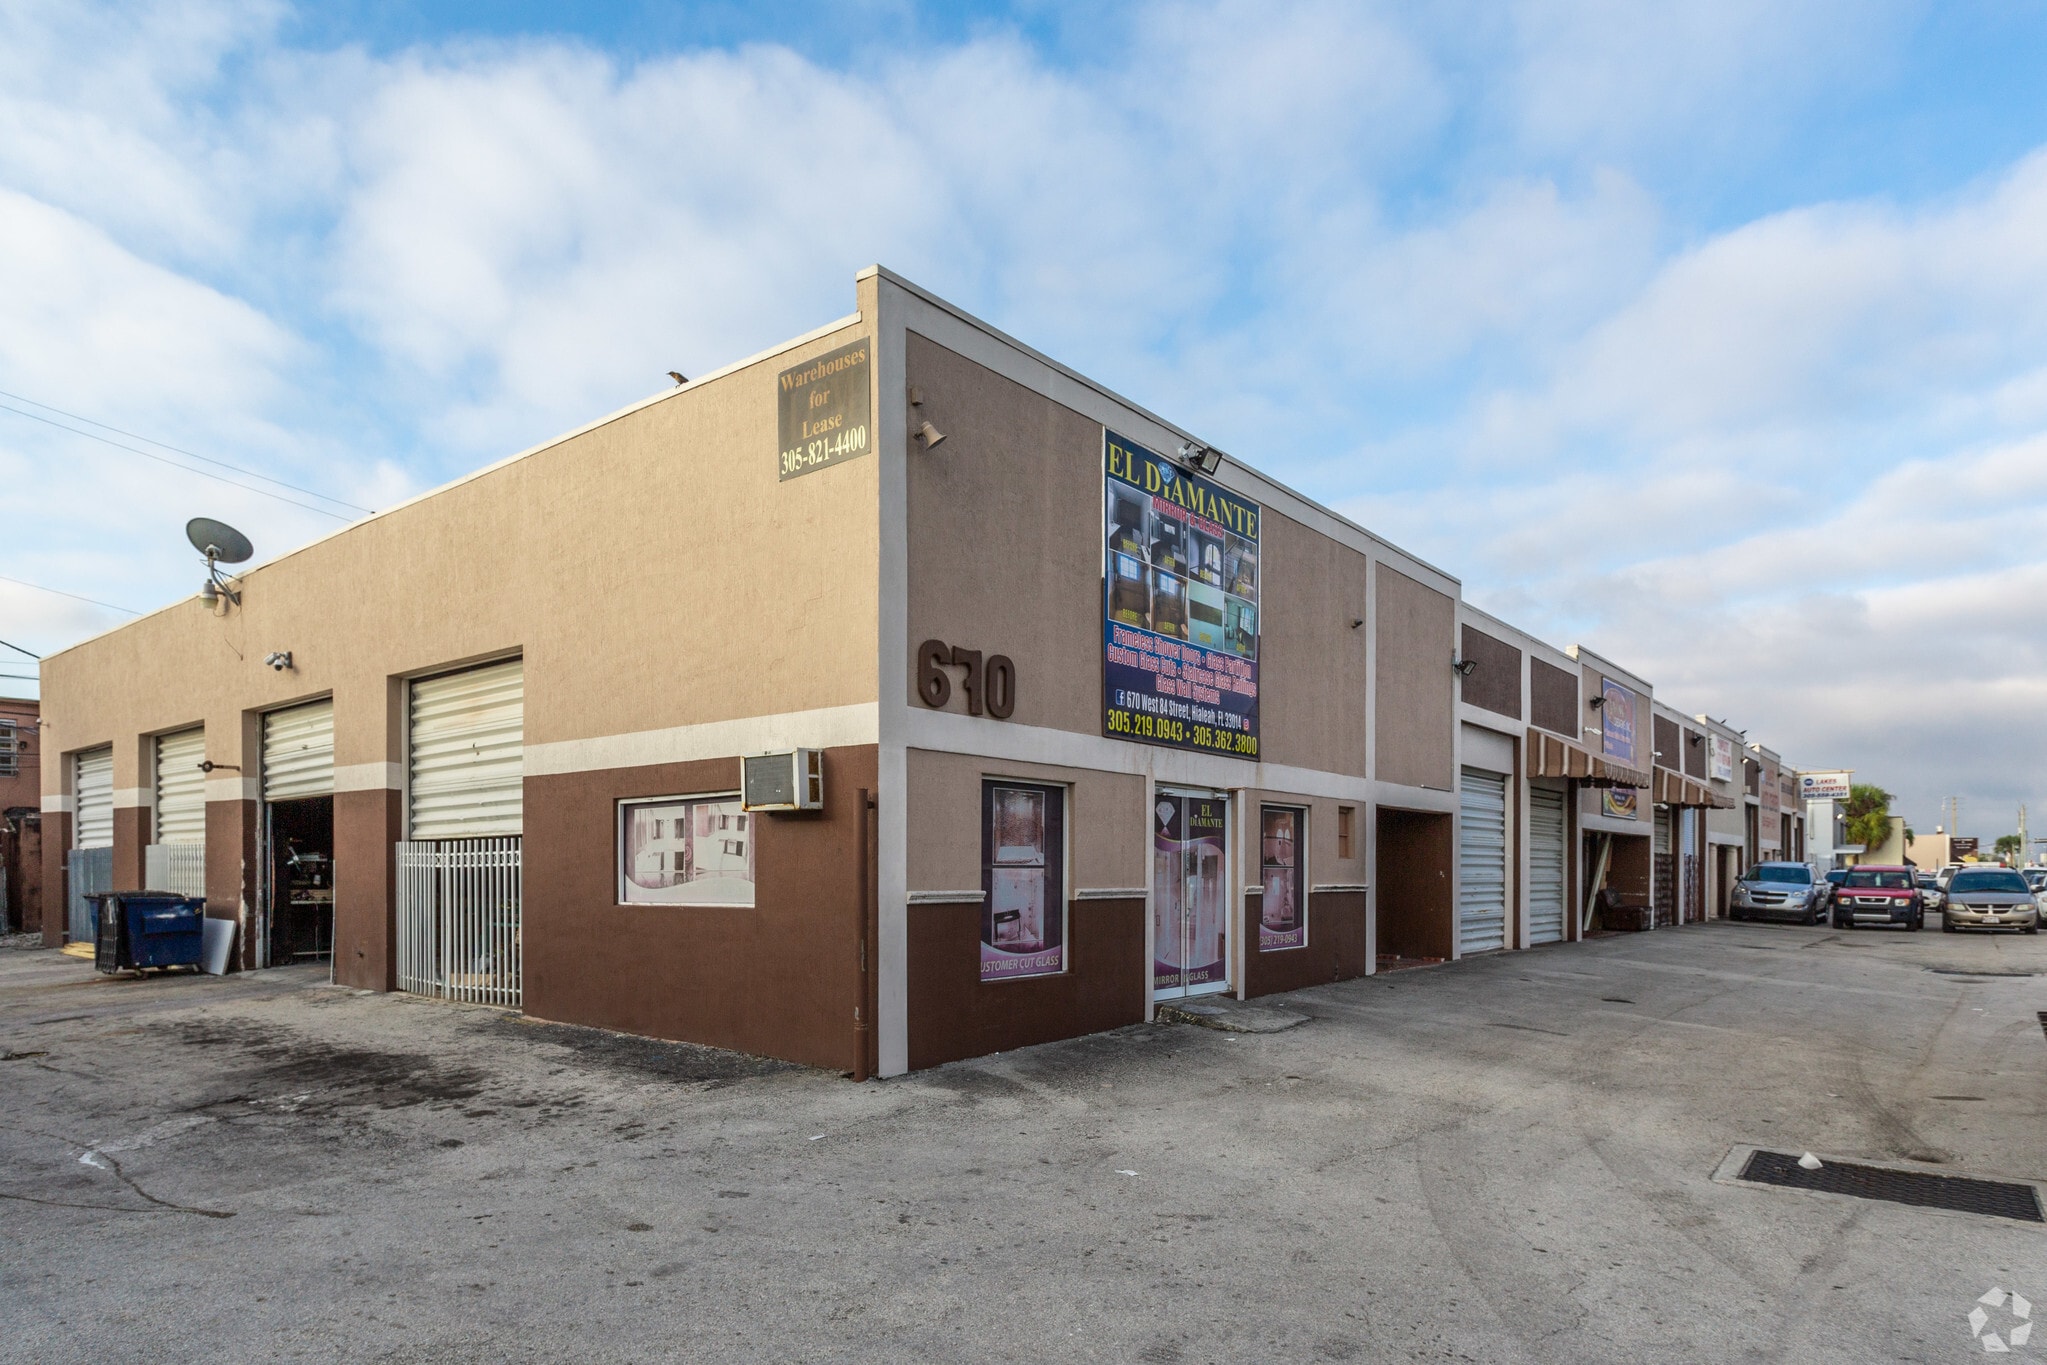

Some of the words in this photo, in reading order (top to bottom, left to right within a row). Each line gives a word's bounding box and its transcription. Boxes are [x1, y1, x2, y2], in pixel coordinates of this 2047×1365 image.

[780, 349, 866, 392] Warehouses
[809, 390, 830, 409] for
[802, 413, 843, 440] Lease
[781, 425, 866, 475] 305-821-4400
[1108, 442, 1140, 485] EL
[1152, 494, 1187, 523] MIRROR
[1107, 642, 1138, 667] Custom
[1139, 651, 1159, 673] Glass
[1161, 656, 1176, 676] Cuts
[1113, 625, 1153, 652] Frameless
[1154, 637, 1181, 659] Shower
[1181, 644, 1201, 665] Doors
[1206, 652, 1225, 671] Glass
[917, 639, 1016, 719] 670
[1156, 674, 1176, 695] Glass
[1176, 679, 1191, 699] Wall
[1126, 690, 1140, 710] 670
[1141, 693, 1159, 713] West
[1159, 699, 1168, 715] 84
[1217, 711, 1225, 726] FL
[1108, 709, 1183, 742] 305.219.0943
[1193, 725, 1257, 755] 305.362.3800
[1201, 804, 1212, 817] EL
[981, 959, 1019, 973] USTOMER
[1020, 957, 1036, 969] CUT
[1036, 955, 1059, 967] GLASS
[1189, 970, 1209, 981] GLASS
